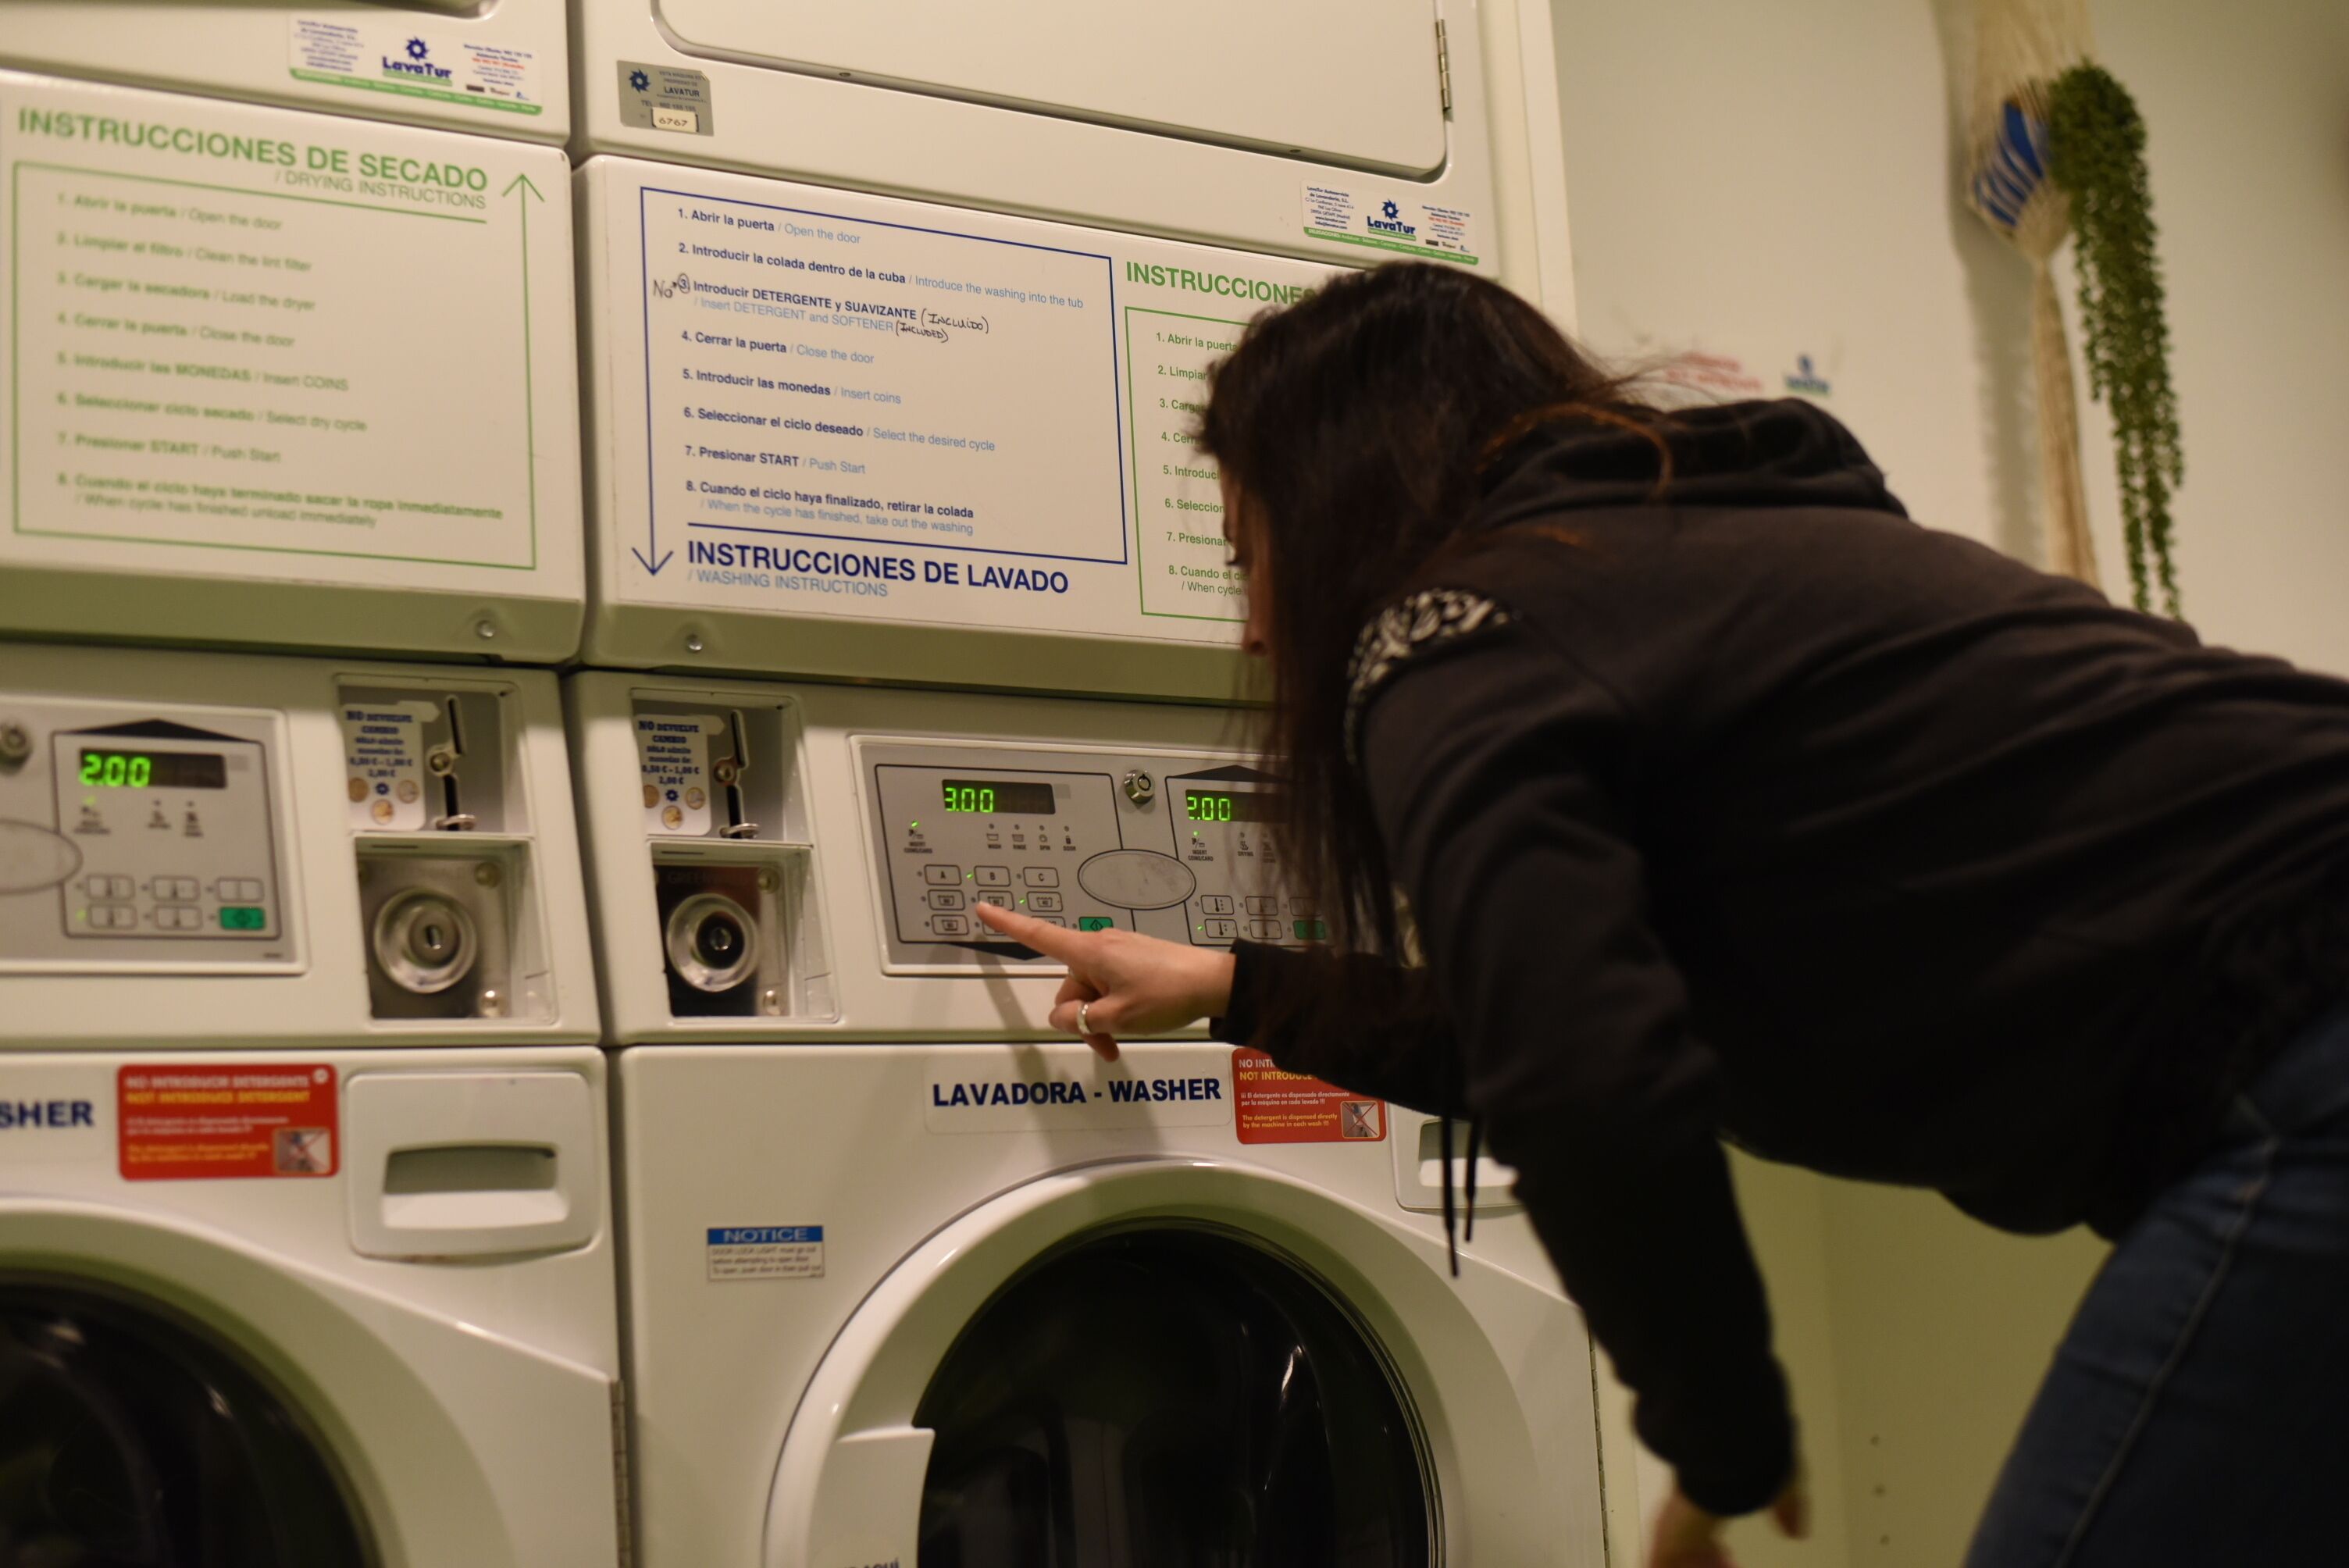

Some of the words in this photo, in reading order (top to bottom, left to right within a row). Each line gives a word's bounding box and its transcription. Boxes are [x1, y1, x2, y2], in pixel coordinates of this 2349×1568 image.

[382, 56, 452, 80] LavaTur
[664, 87, 700, 97] LAVATUR
[659, 117, 688, 127] 6767
[20, 108, 296, 166] INSTRUCCIONES
[308, 146, 348, 173] DE
[360, 153, 487, 192] SECADO
[286, 171, 353, 192] DRYING
[359, 180, 486, 208] INSTRUCTIONS
[678, 208, 688, 219] 1.
[691, 209, 721, 223] Abrir
[723, 214, 734, 226] la
[736, 218, 775, 232] puerta
[783, 223, 814, 237] Open
[816, 228, 834, 241] the
[836, 230, 861, 244] door
[1367, 216, 1416, 235] LavaTur
[679, 242, 689, 254] 2.
[692, 244, 750, 262] Introducir
[753, 252, 764, 264] la
[766, 256, 805, 270] colada
[807, 261, 846, 276] dentro
[848, 266, 863, 278] de
[865, 269, 875, 280] la
[878, 271, 906, 283] cuba
[915, 274, 963, 292] Introduce
[965, 282, 982, 294] the
[984, 287, 1026, 304] washing
[1028, 291, 1047, 303] into
[1049, 294, 1065, 306] the
[1068, 297, 1084, 309] tub
[693, 281, 750, 298] Introducir
[752, 288, 832, 309] DETERGENTE
[835, 301, 842, 312] y
[844, 301, 918, 320] SUAVIZANTE
[700, 298, 731, 311] Insert
[733, 301, 807, 320] DETERGENT
[808, 313, 829, 324] and
[831, 313, 894, 332] SOFTENER
[681, 330, 692, 341] 4.
[695, 331, 733, 346] Cerrar
[735, 337, 747, 348] la
[749, 340, 787, 353] puerta
[796, 344, 829, 358] Close
[829, 348, 848, 362] the
[850, 351, 875, 364] door
[1156, 332, 1164, 342] 1.
[1168, 333, 1192, 346] Abrir
[1195, 337, 1204, 347] la
[1207, 340, 1238, 351] puerta
[1157, 365, 1167, 376] 2.
[1169, 366, 1208, 381] Limpiar
[683, 368, 693, 380] 5.
[696, 369, 754, 387] Introducir
[757, 376, 775, 390] las
[777, 381, 832, 396] monedas
[840, 387, 872, 401] Insert
[872, 391, 902, 404] coins
[1160, 398, 1168, 408] 3.
[683, 406, 695, 419] 6.
[697, 407, 768, 426] Seleccionar
[769, 416, 781, 428] el
[783, 419, 812, 431] ciclo
[814, 421, 864, 437] deseado
[872, 427, 907, 442] Select
[908, 432, 925, 444] the
[927, 434, 967, 448] desired
[968, 440, 996, 453] cycle
[1161, 431, 1170, 442] 4.
[685, 444, 696, 457] 7.
[698, 446, 757, 462] Presionar
[758, 452, 800, 467] START
[808, 458, 838, 472] Push
[839, 460, 866, 474] Start
[1163, 465, 1171, 475] 5.
[1174, 465, 1221, 480] Introduci
[686, 480, 697, 491] 8.
[700, 481, 747, 497] Cuando
[749, 486, 761, 498] el
[762, 489, 792, 501] ciclo
[794, 490, 823, 505] haya
[825, 494, 884, 511] finalizado,
[886, 501, 921, 513] retirar
[924, 503, 935, 515] la
[936, 506, 974, 519] colada
[1164, 498, 1174, 508] 6.
[1177, 499, 1225, 513] Seleccion
[707, 499, 741, 511] When
[743, 502, 761, 515] the
[762, 505, 793, 518] cycle
[794, 507, 816, 519] has
[817, 509, 863, 525] finished,
[865, 515, 889, 526] take
[891, 518, 909, 528] out
[911, 518, 929, 530] the
[930, 521, 974, 536] washing
[1167, 531, 1175, 542] 7.
[1178, 533, 1228, 547] Presionar
[688, 540, 916, 582] INSTRUCCIONES
[924, 560, 960, 586] DE
[967, 564, 1069, 593] LAVADO
[1168, 565, 1178, 575] 8.
[1180, 565, 1220, 579] Cuando
[1222, 569, 1232, 580] el
[696, 568, 771, 588] WASHING
[775, 575, 889, 597] INSTRUCTIONS
[1187, 581, 1215, 593] When
[1217, 585, 1242, 597] cycle
[80, 753, 152, 788] 2.00
[944, 787, 994, 814] 3.00
[1187, 796, 1231, 821] 2.00
[939, 871, 946, 880] A
[989, 872, 996, 881] B
[1038, 873, 1045, 882] C
[1239, 1059, 1253, 1068] NO
[1239, 1071, 1259, 1081] NOT
[932, 1081, 1087, 1107] LAVADORA
[1108, 1078, 1222, 1104] WASHER
[1253, 1092, 1281, 1100] detergente
[0, 1100, 94, 1129] SHER
[723, 1228, 808, 1243] NOTICE
